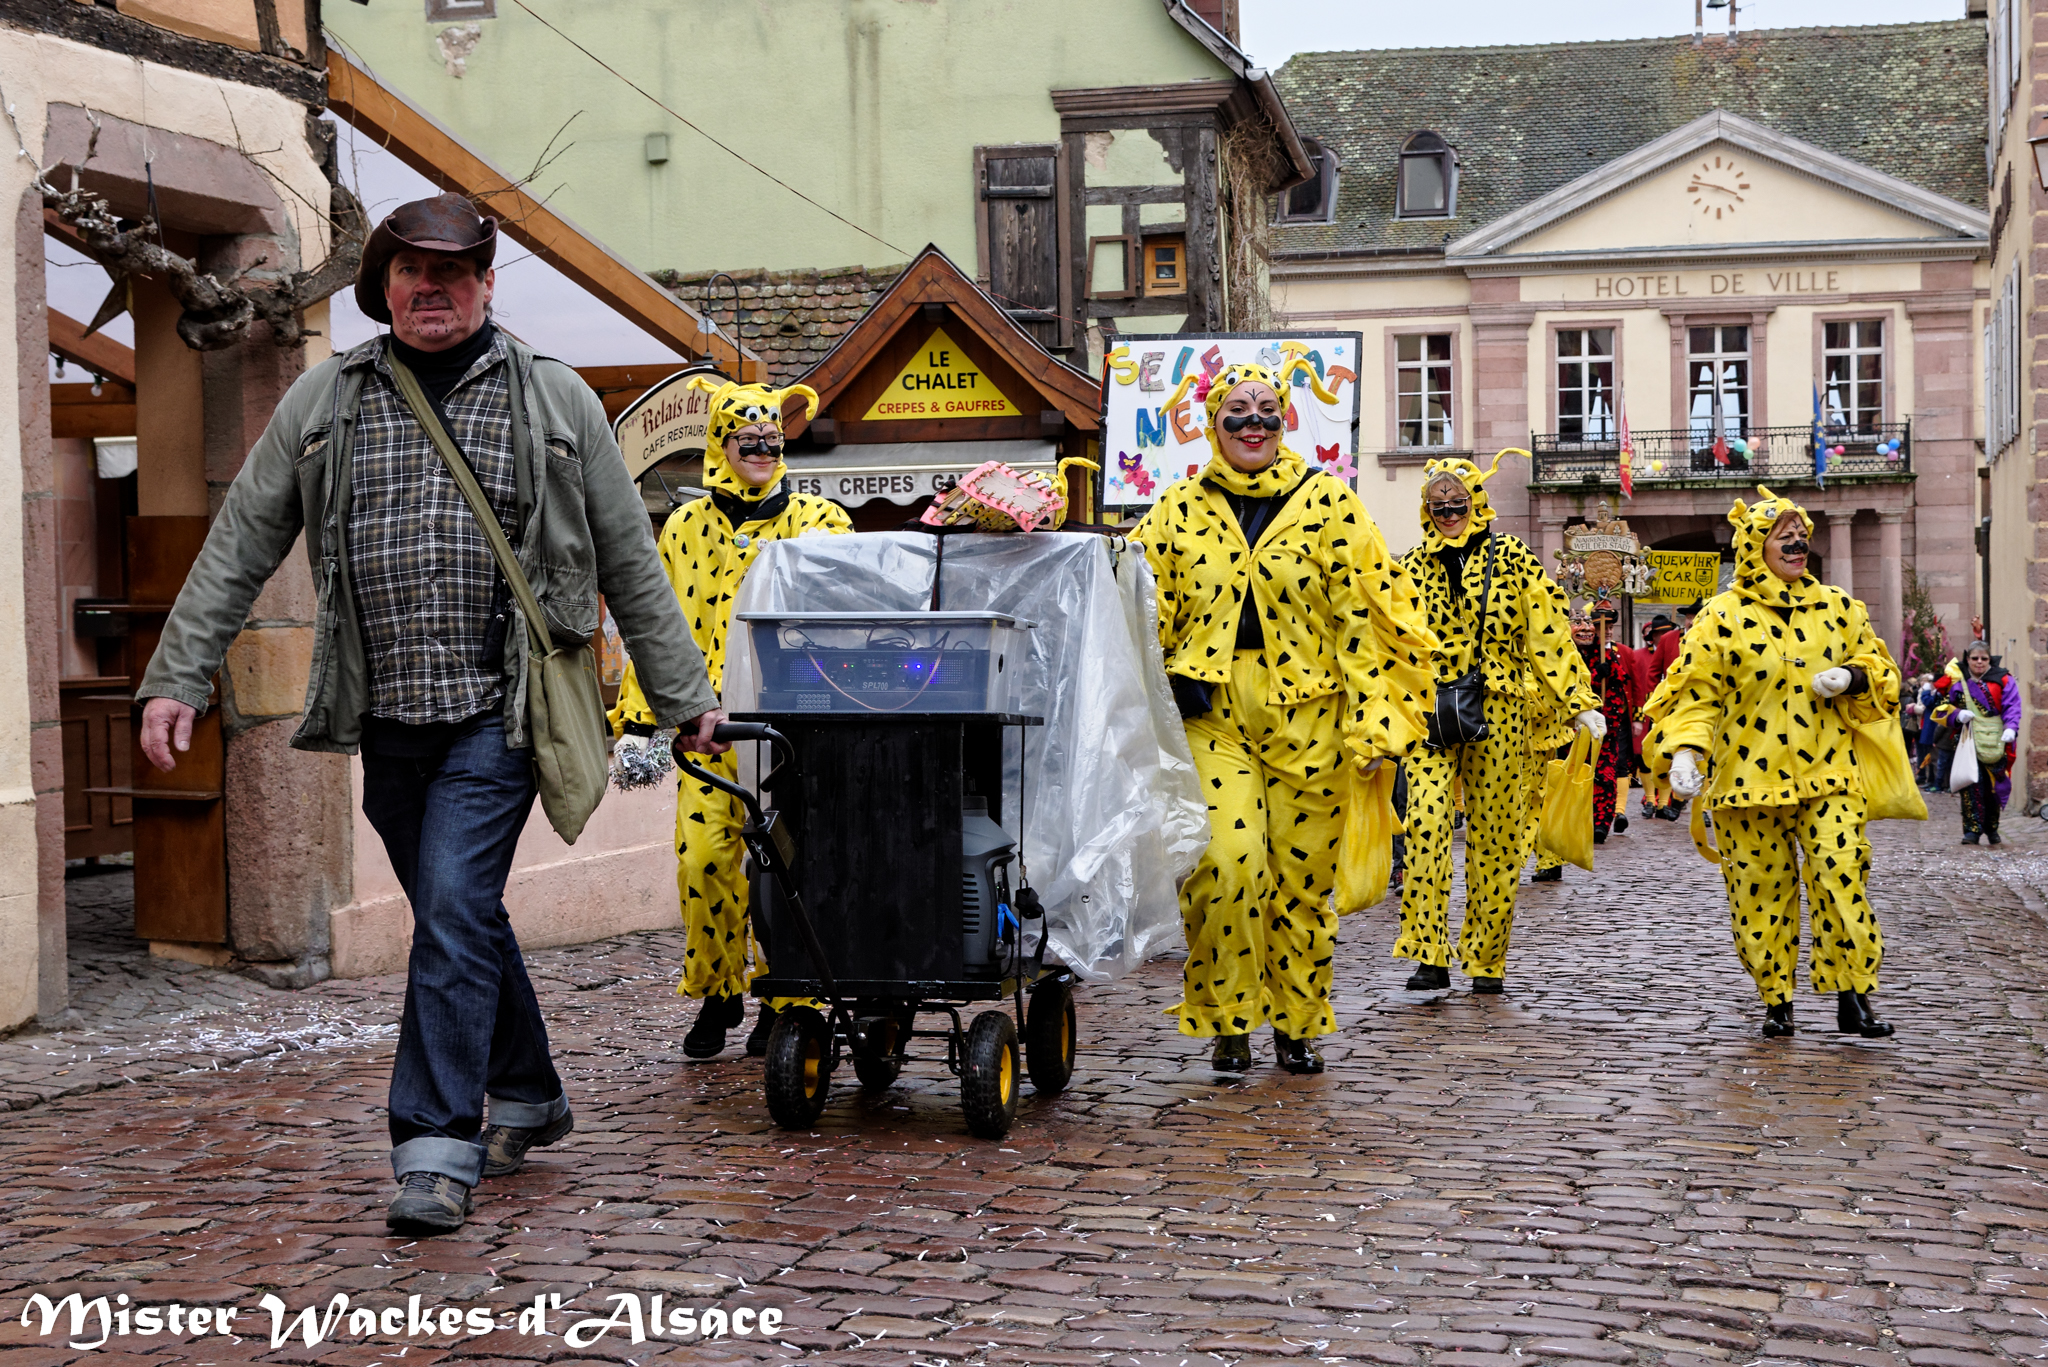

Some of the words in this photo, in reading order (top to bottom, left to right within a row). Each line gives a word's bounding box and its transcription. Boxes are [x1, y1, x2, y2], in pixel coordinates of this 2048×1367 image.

[1595, 275, 1688, 297] HOTEL
[1710, 273, 1745, 294] DE
[1766, 271, 1840, 292] VILLE
[929, 350, 950, 368] LE
[902, 372, 979, 391] CHALET
[641, 392, 683, 439] Relais
[686, 389, 701, 415] de
[878, 402, 926, 414] CREPES
[930, 401, 941, 412] &
[945, 399, 1006, 412] GAUFRES
[643, 435, 666, 460] CAFE
[839, 474, 914, 496] CREPES
[1573, 542, 1592, 550] WEIL
[1608, 542, 1632, 551] STADT
[1663, 571, 1693, 582] CAR
